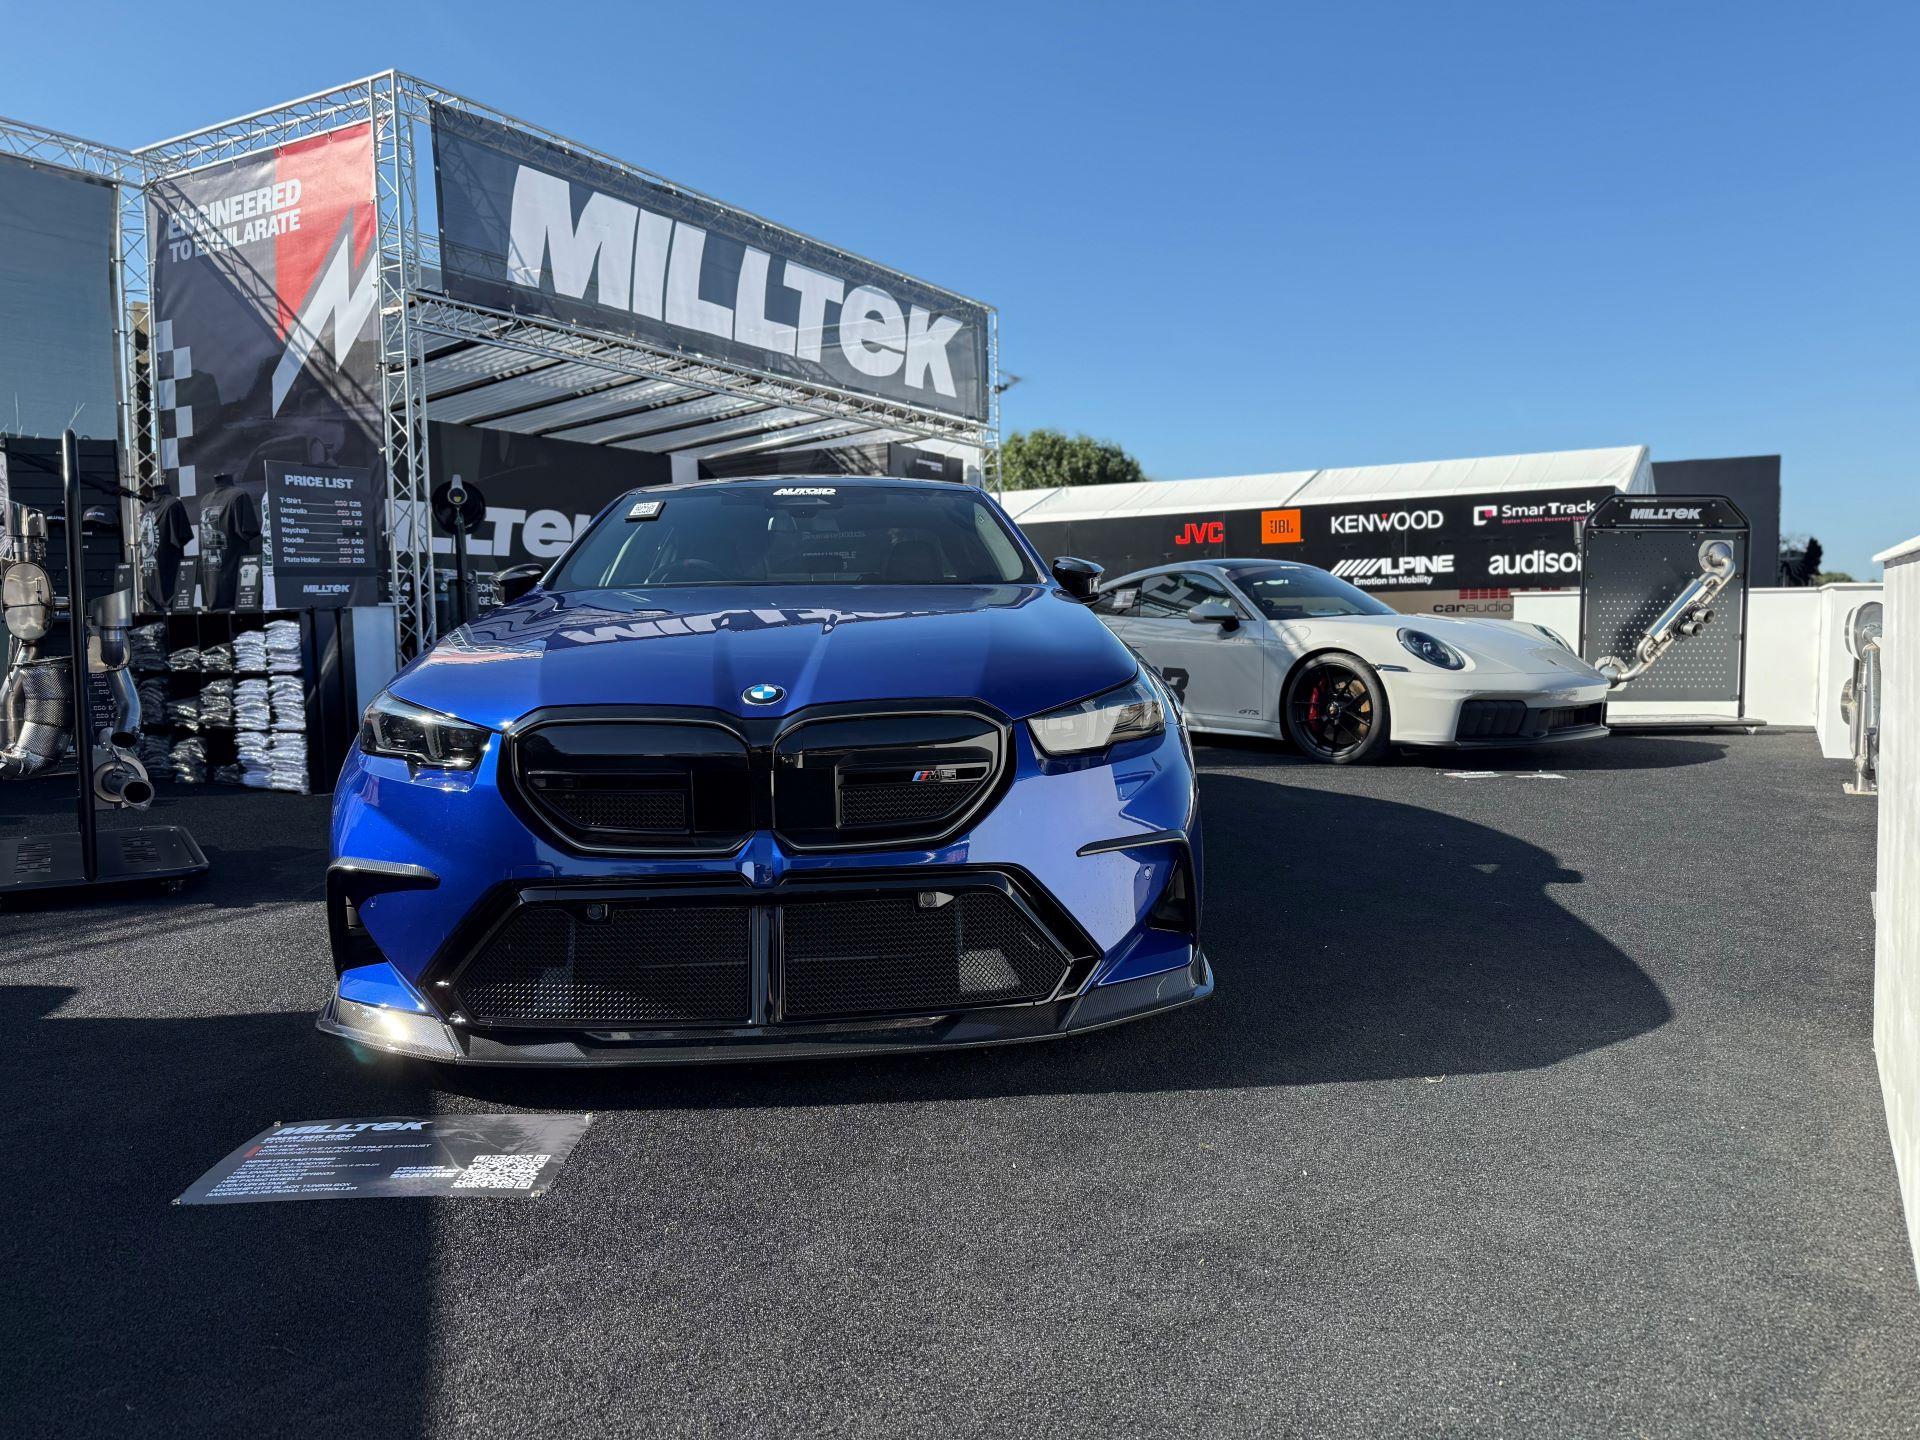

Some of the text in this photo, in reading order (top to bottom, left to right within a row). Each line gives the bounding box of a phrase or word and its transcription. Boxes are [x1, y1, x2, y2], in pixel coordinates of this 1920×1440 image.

[167, 178, 302, 240] ENGINEERED
[169, 239, 192, 263] TO
[285, 474, 354, 489] PRICE LIST
[1269, 519, 1294, 534] JBL
[1330, 510, 1444, 534] KENWOOD
[1175, 521, 1224, 545] JVC
[283, 546, 296, 554] Cap
[1365, 554, 1454, 576] ALPINE
[1488, 549, 1582, 575] audiso
[1353, 574, 1433, 586] Emotion in Mobility
[1433, 601, 1513, 613] caraudio
[1238, 708, 1260, 716] GTS
